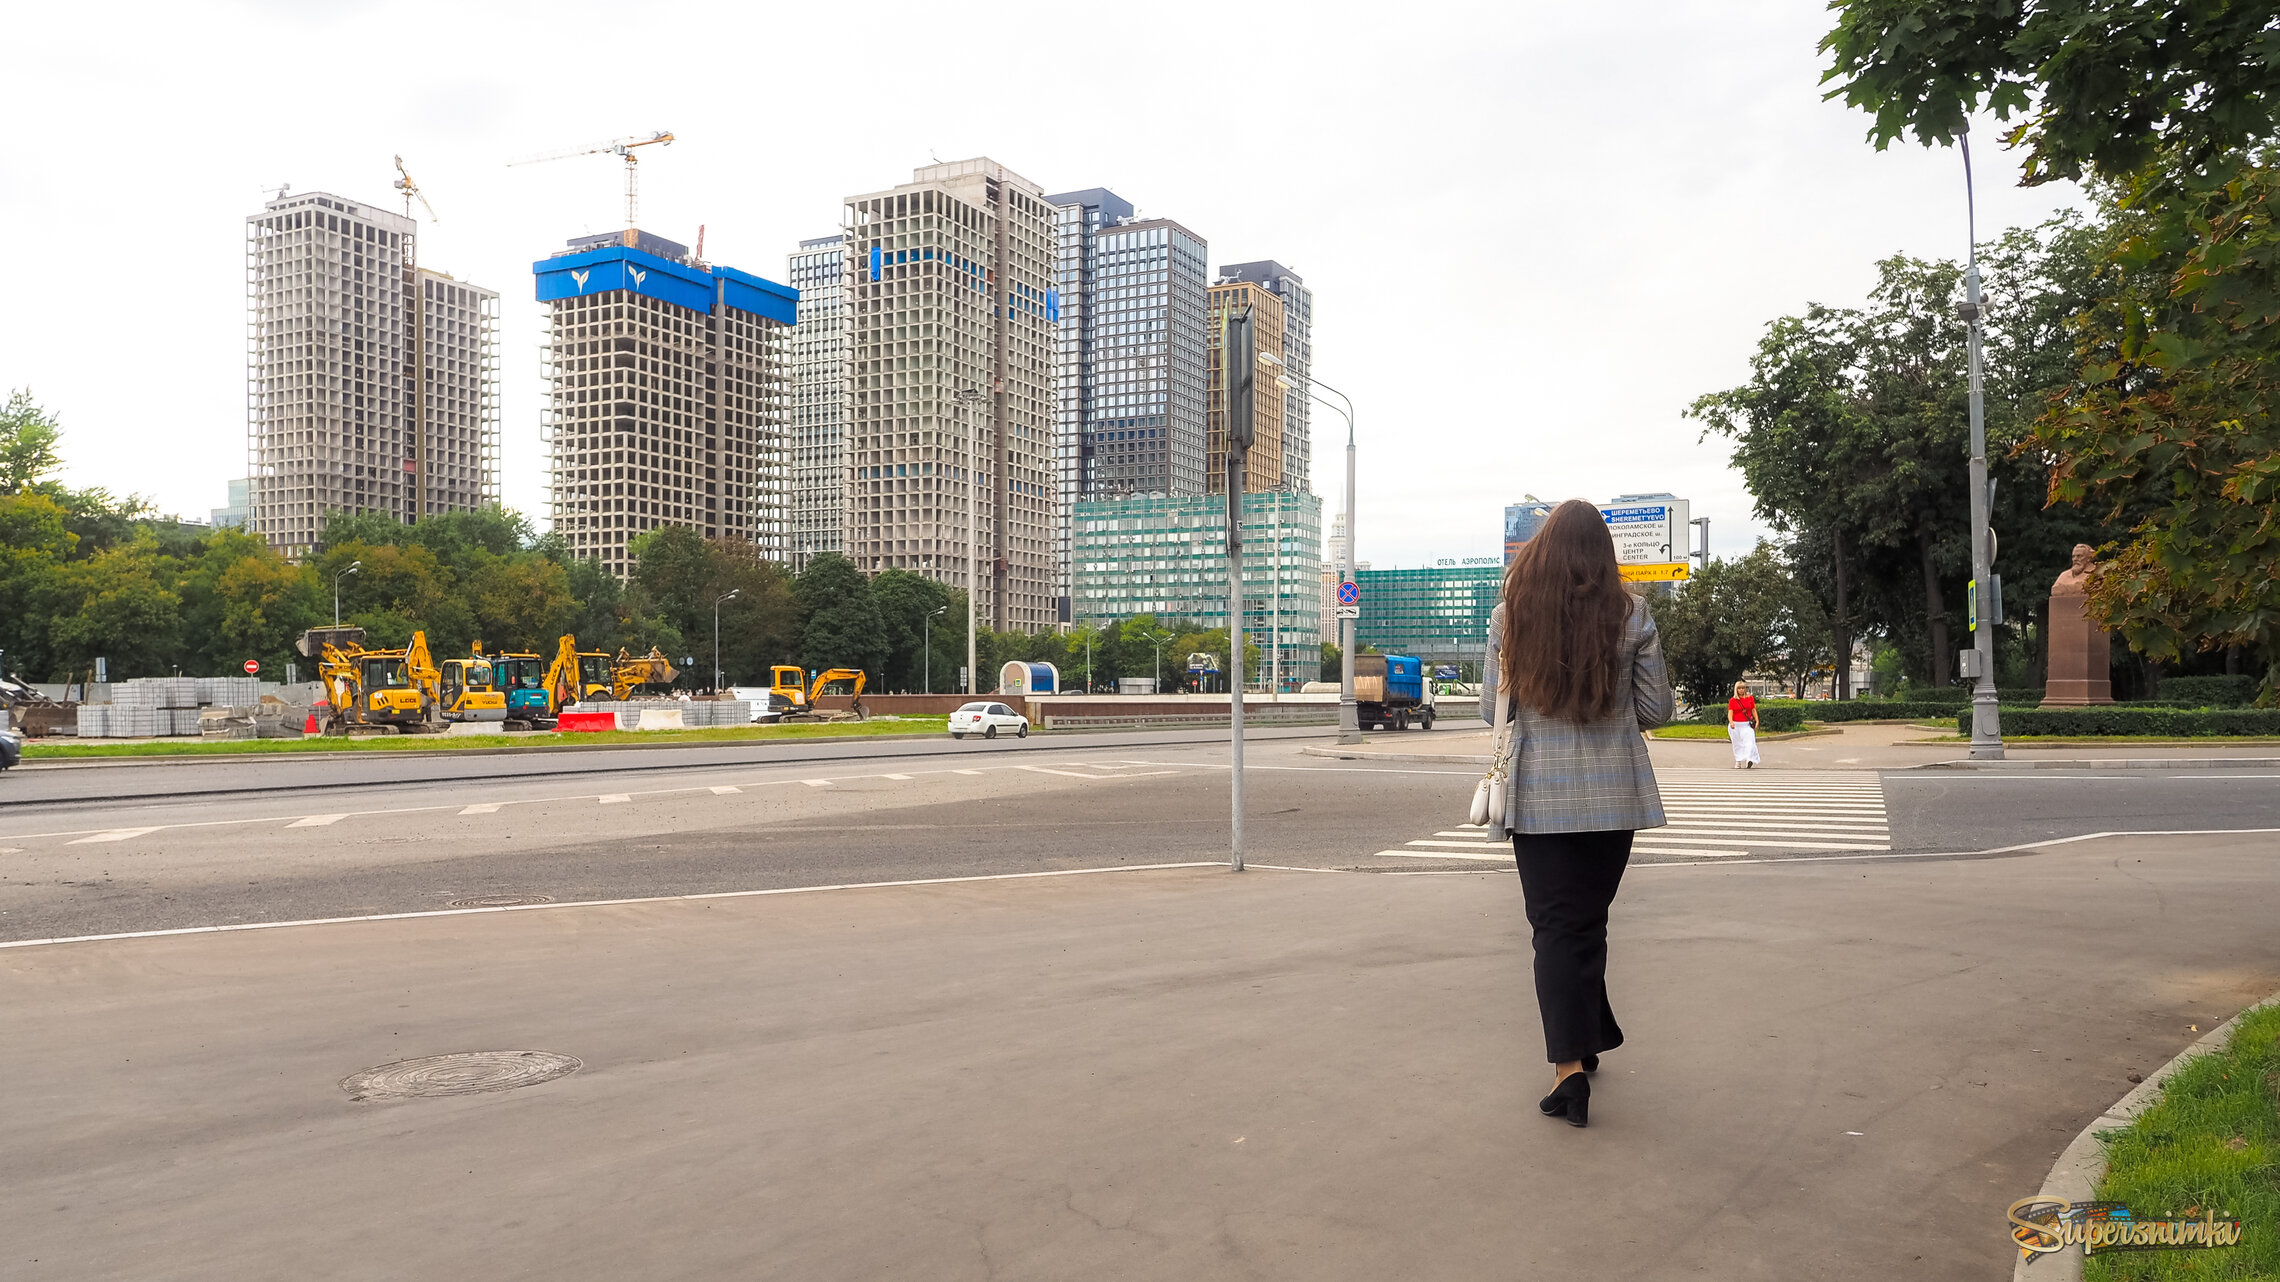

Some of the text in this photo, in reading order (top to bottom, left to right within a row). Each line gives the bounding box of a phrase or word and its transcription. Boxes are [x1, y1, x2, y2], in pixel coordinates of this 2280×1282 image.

[1611, 507, 1660, 516] ШЕРЕМЕТЬЕВО
[1609, 523, 1656, 531] ЛОКОЛАМСКОЕ
[1611, 530, 1653, 538] ИНГРАДСКОЕ
[1437, 557, 1500, 566] ОТЕЛЬ АЭРОПОЛИС
